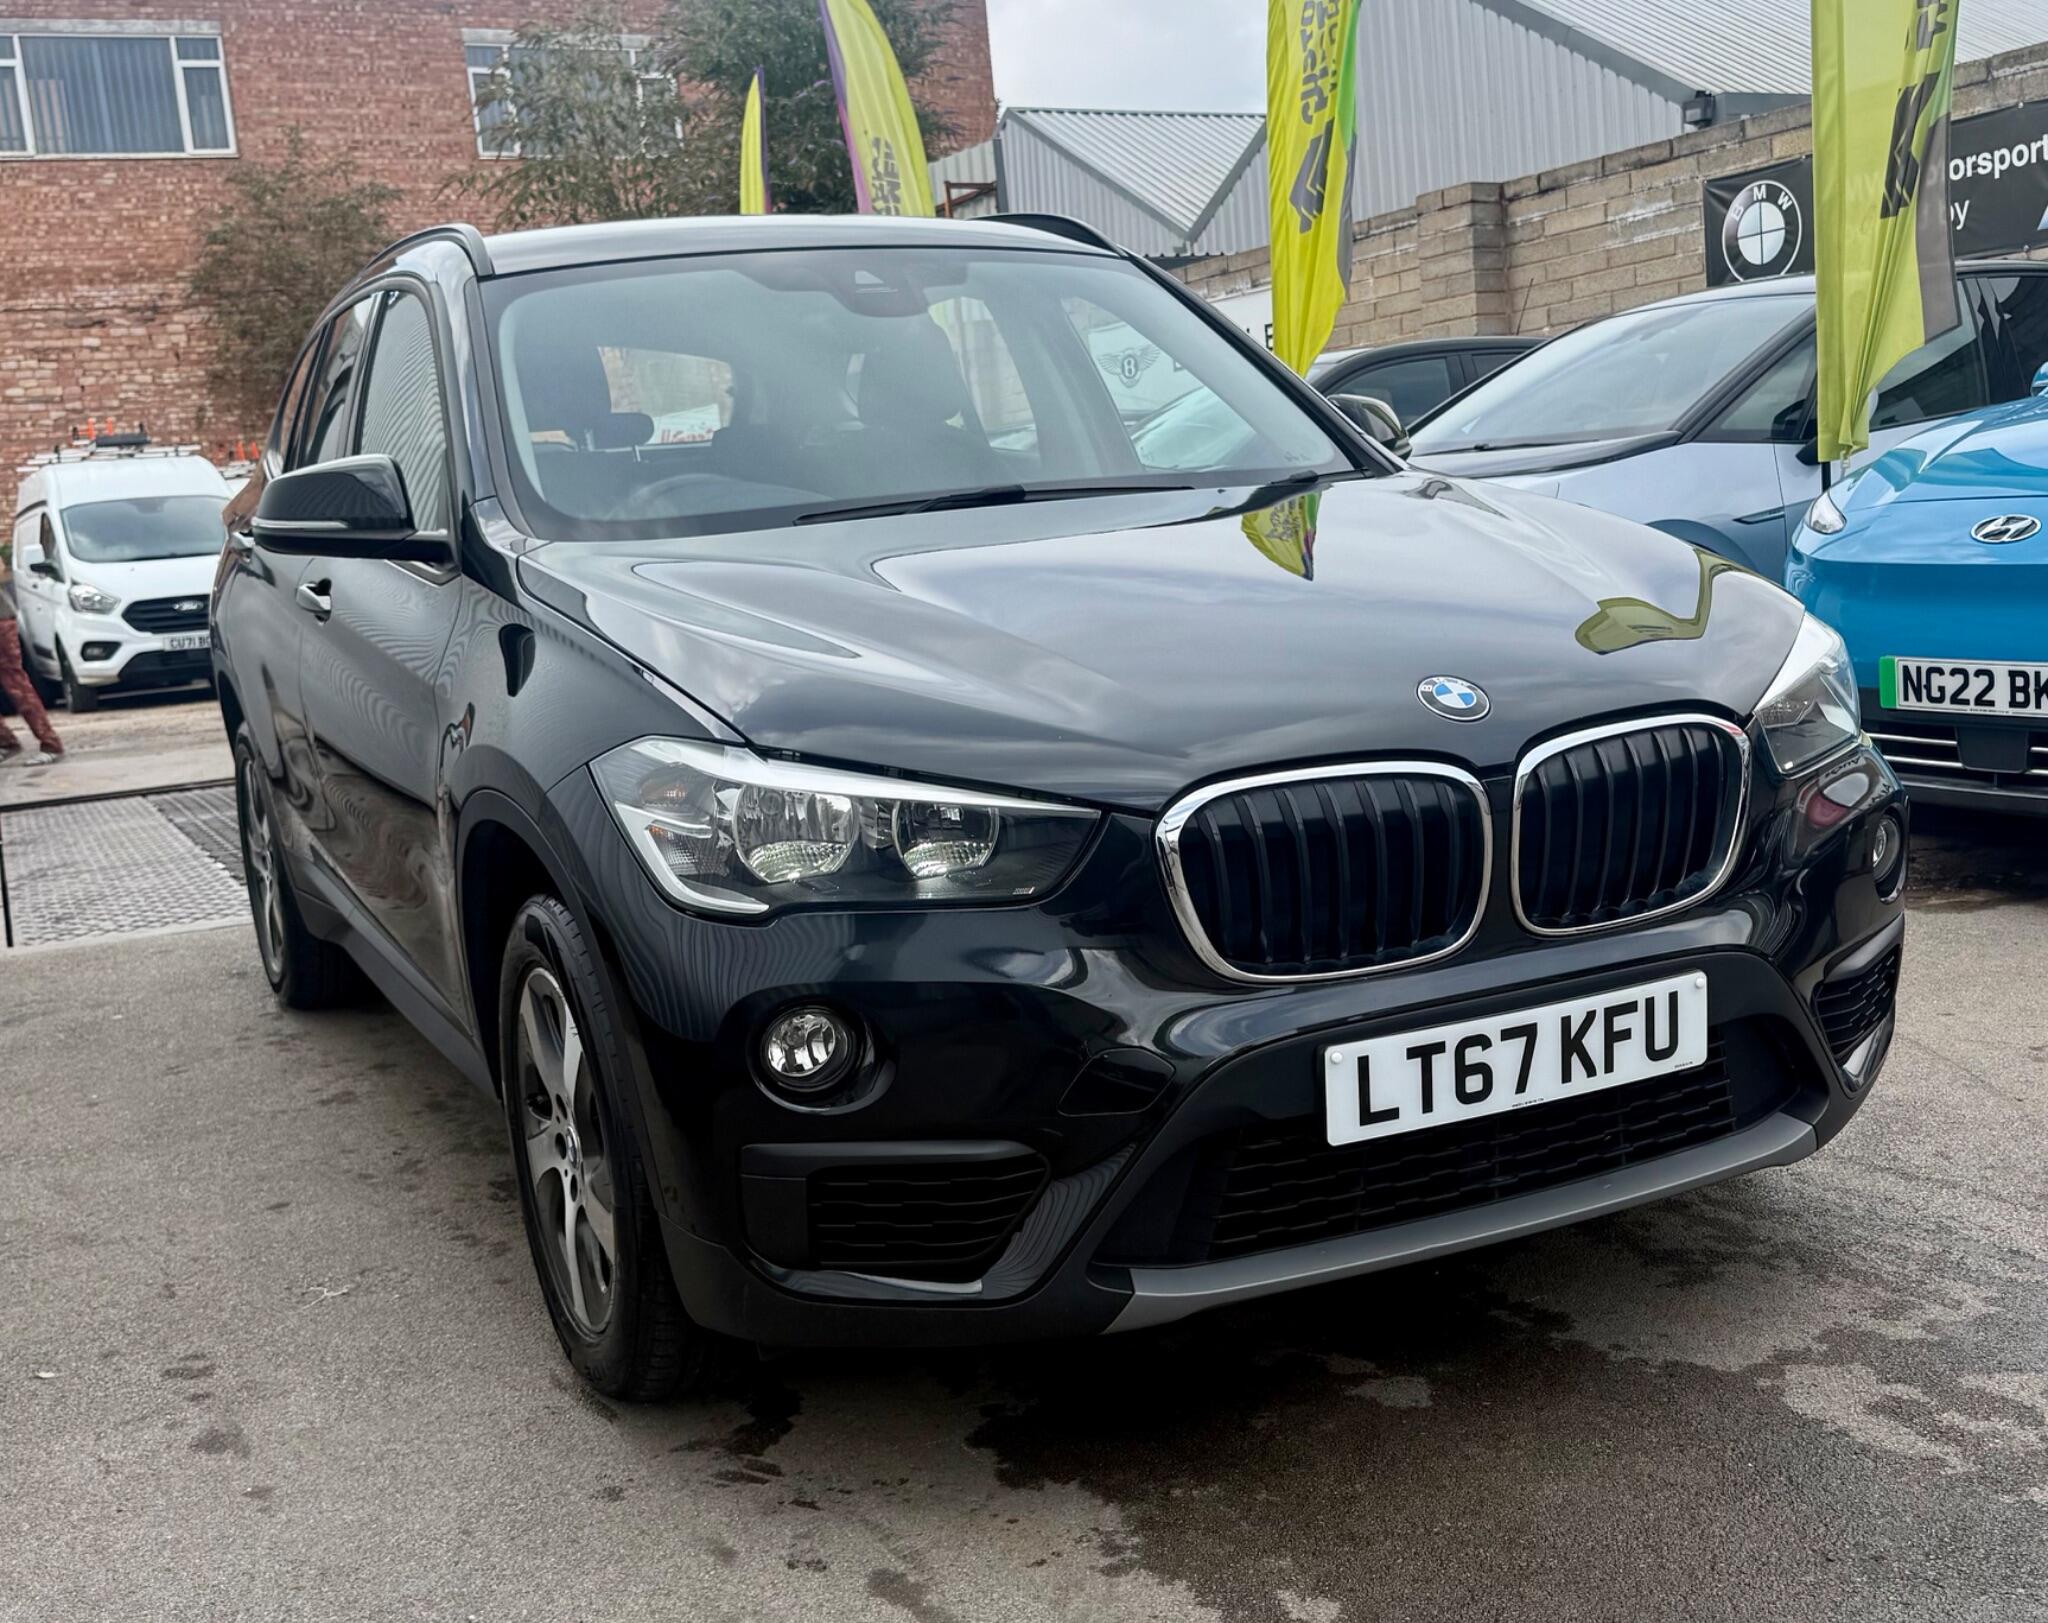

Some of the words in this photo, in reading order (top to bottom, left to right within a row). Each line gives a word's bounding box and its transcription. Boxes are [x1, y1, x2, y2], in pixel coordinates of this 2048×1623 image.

[1949, 133, 2048, 180] orsport
[1730, 183, 1793, 221] BMW
[1902, 665, 1995, 708] NG22
[1357, 1022, 1538, 1127] LT67
[1560, 990, 1679, 1085] KFU
